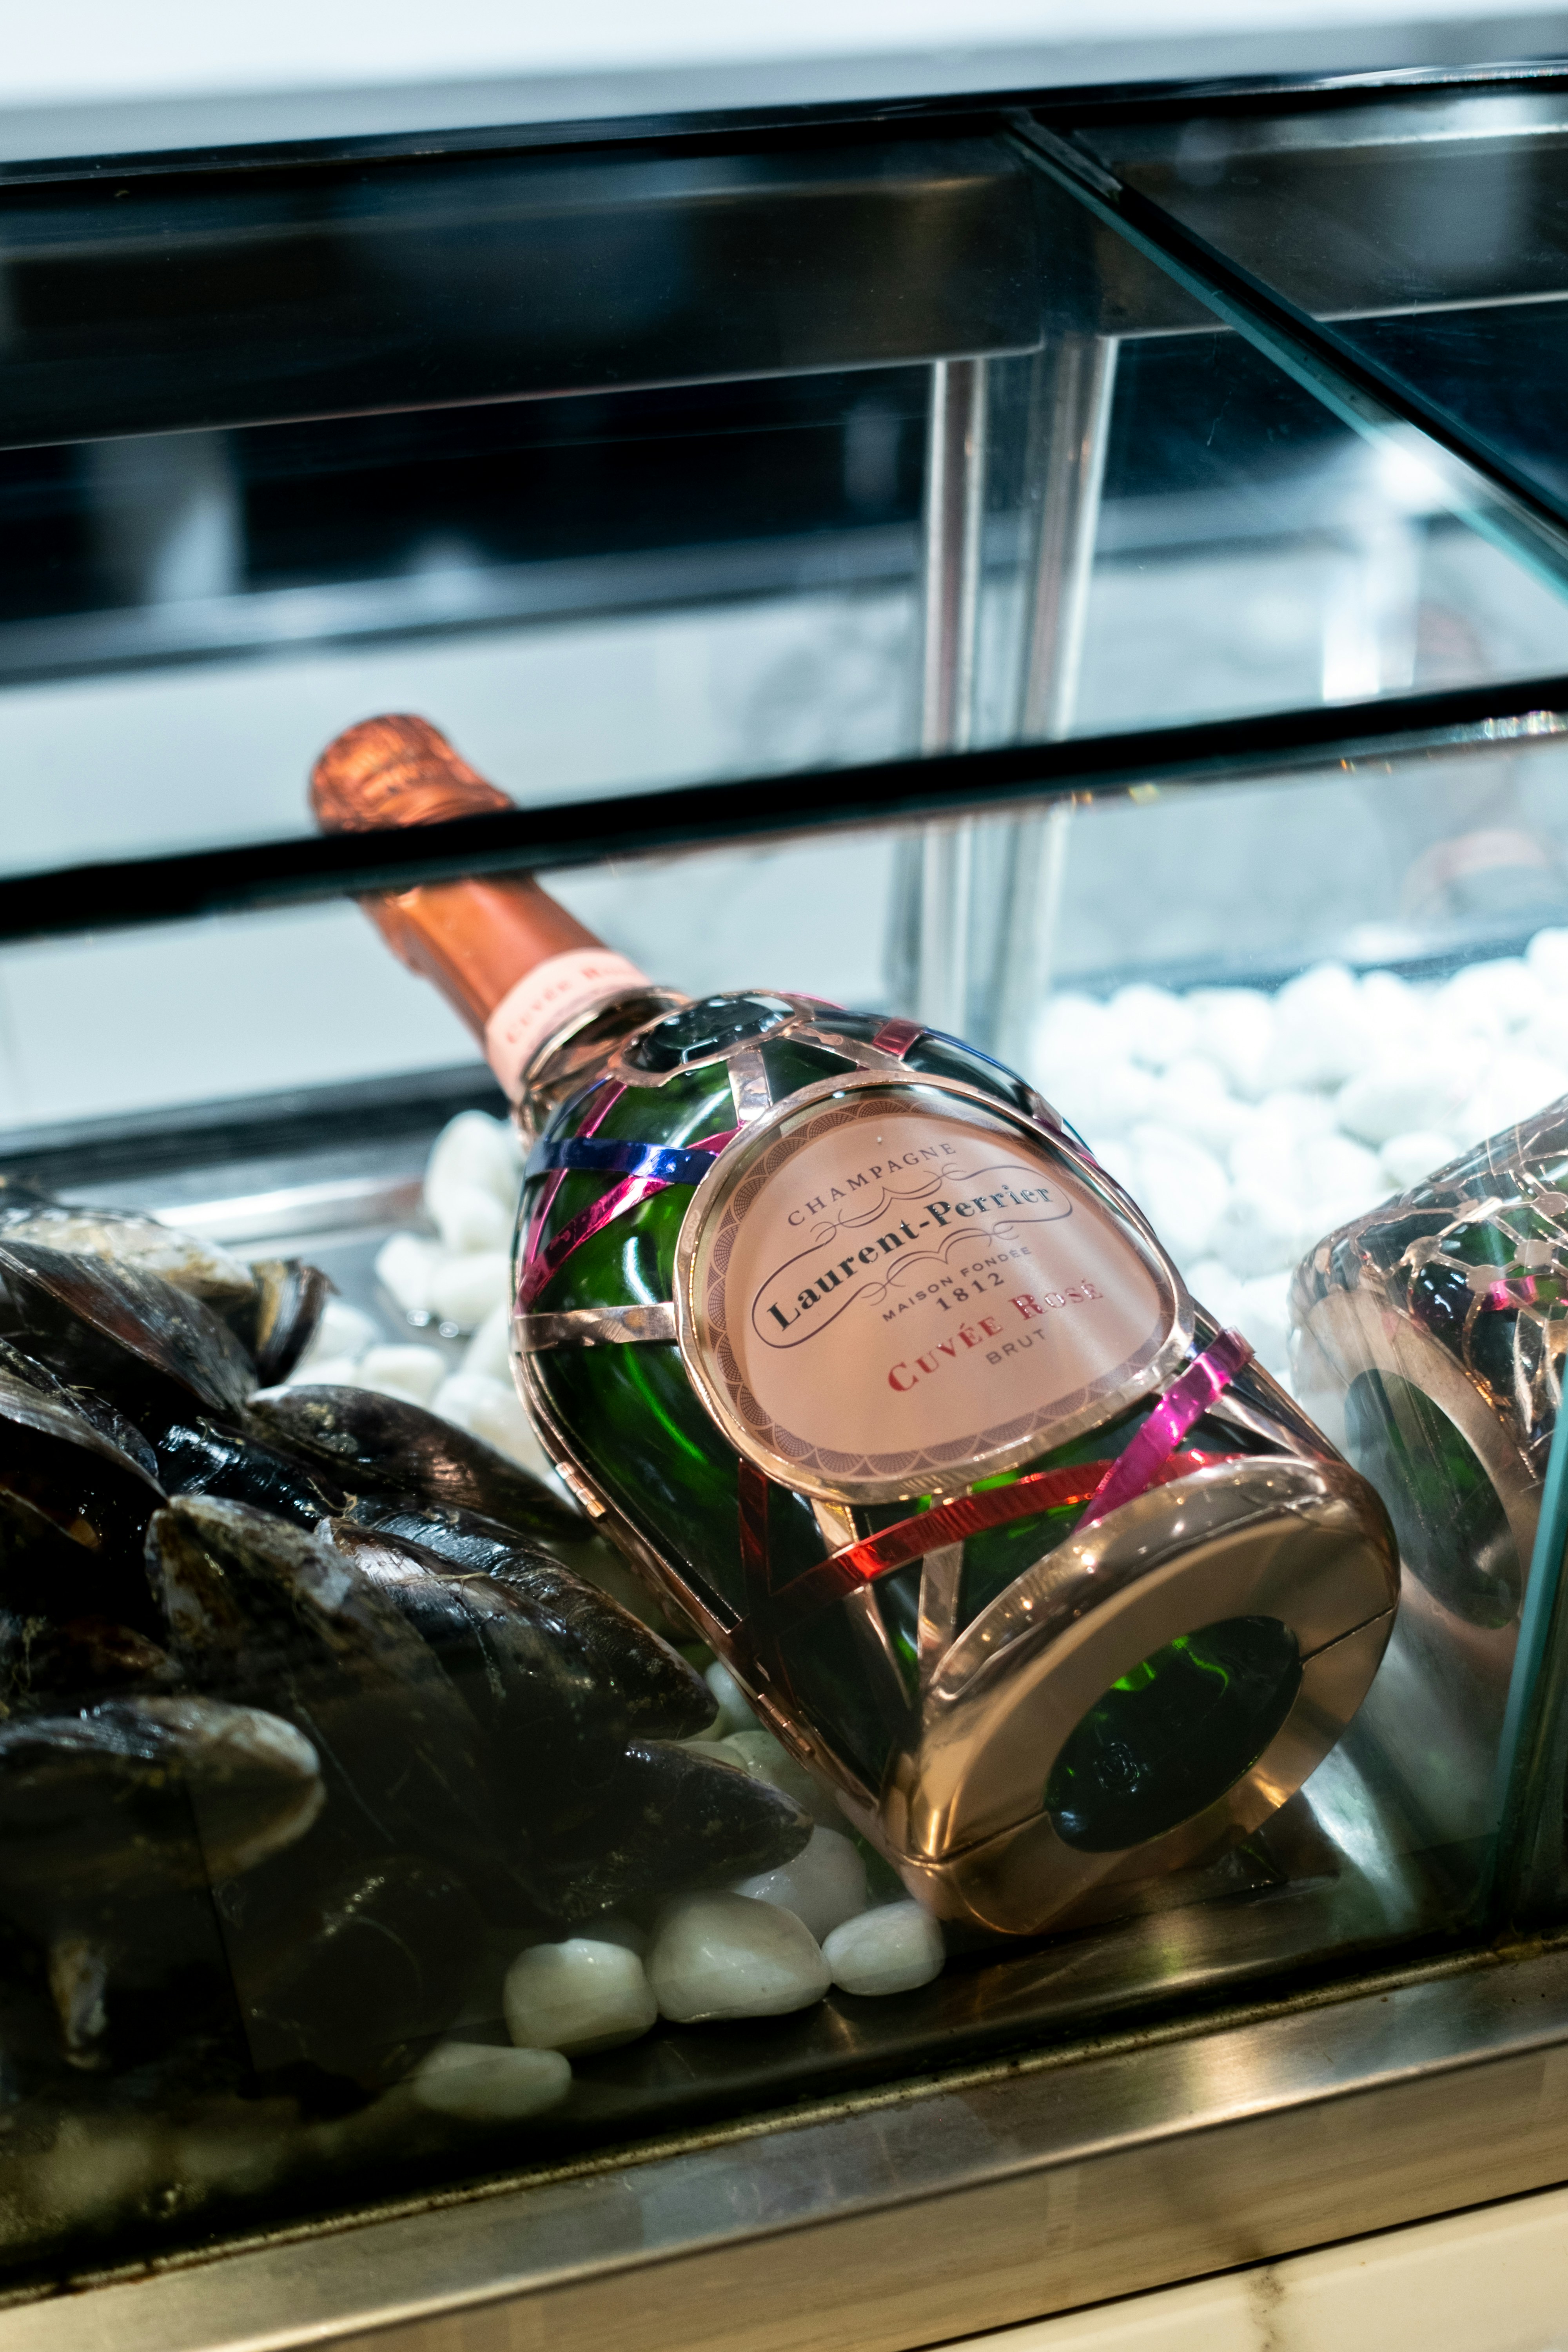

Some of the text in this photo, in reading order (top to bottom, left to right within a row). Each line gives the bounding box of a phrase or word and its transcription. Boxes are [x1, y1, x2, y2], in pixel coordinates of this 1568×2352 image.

[788, 1143, 956, 1226] CHAMPAGNE
[767, 1184, 1053, 1332] Laurent-Perrier
[882, 1246, 1031, 1322] MAISON FONDÉE
[936, 1272, 1004, 1311] 1812
[888, 1278, 1103, 1392] CUVÉE ROSÉ
[985, 1328, 1046, 1365] BRUT
